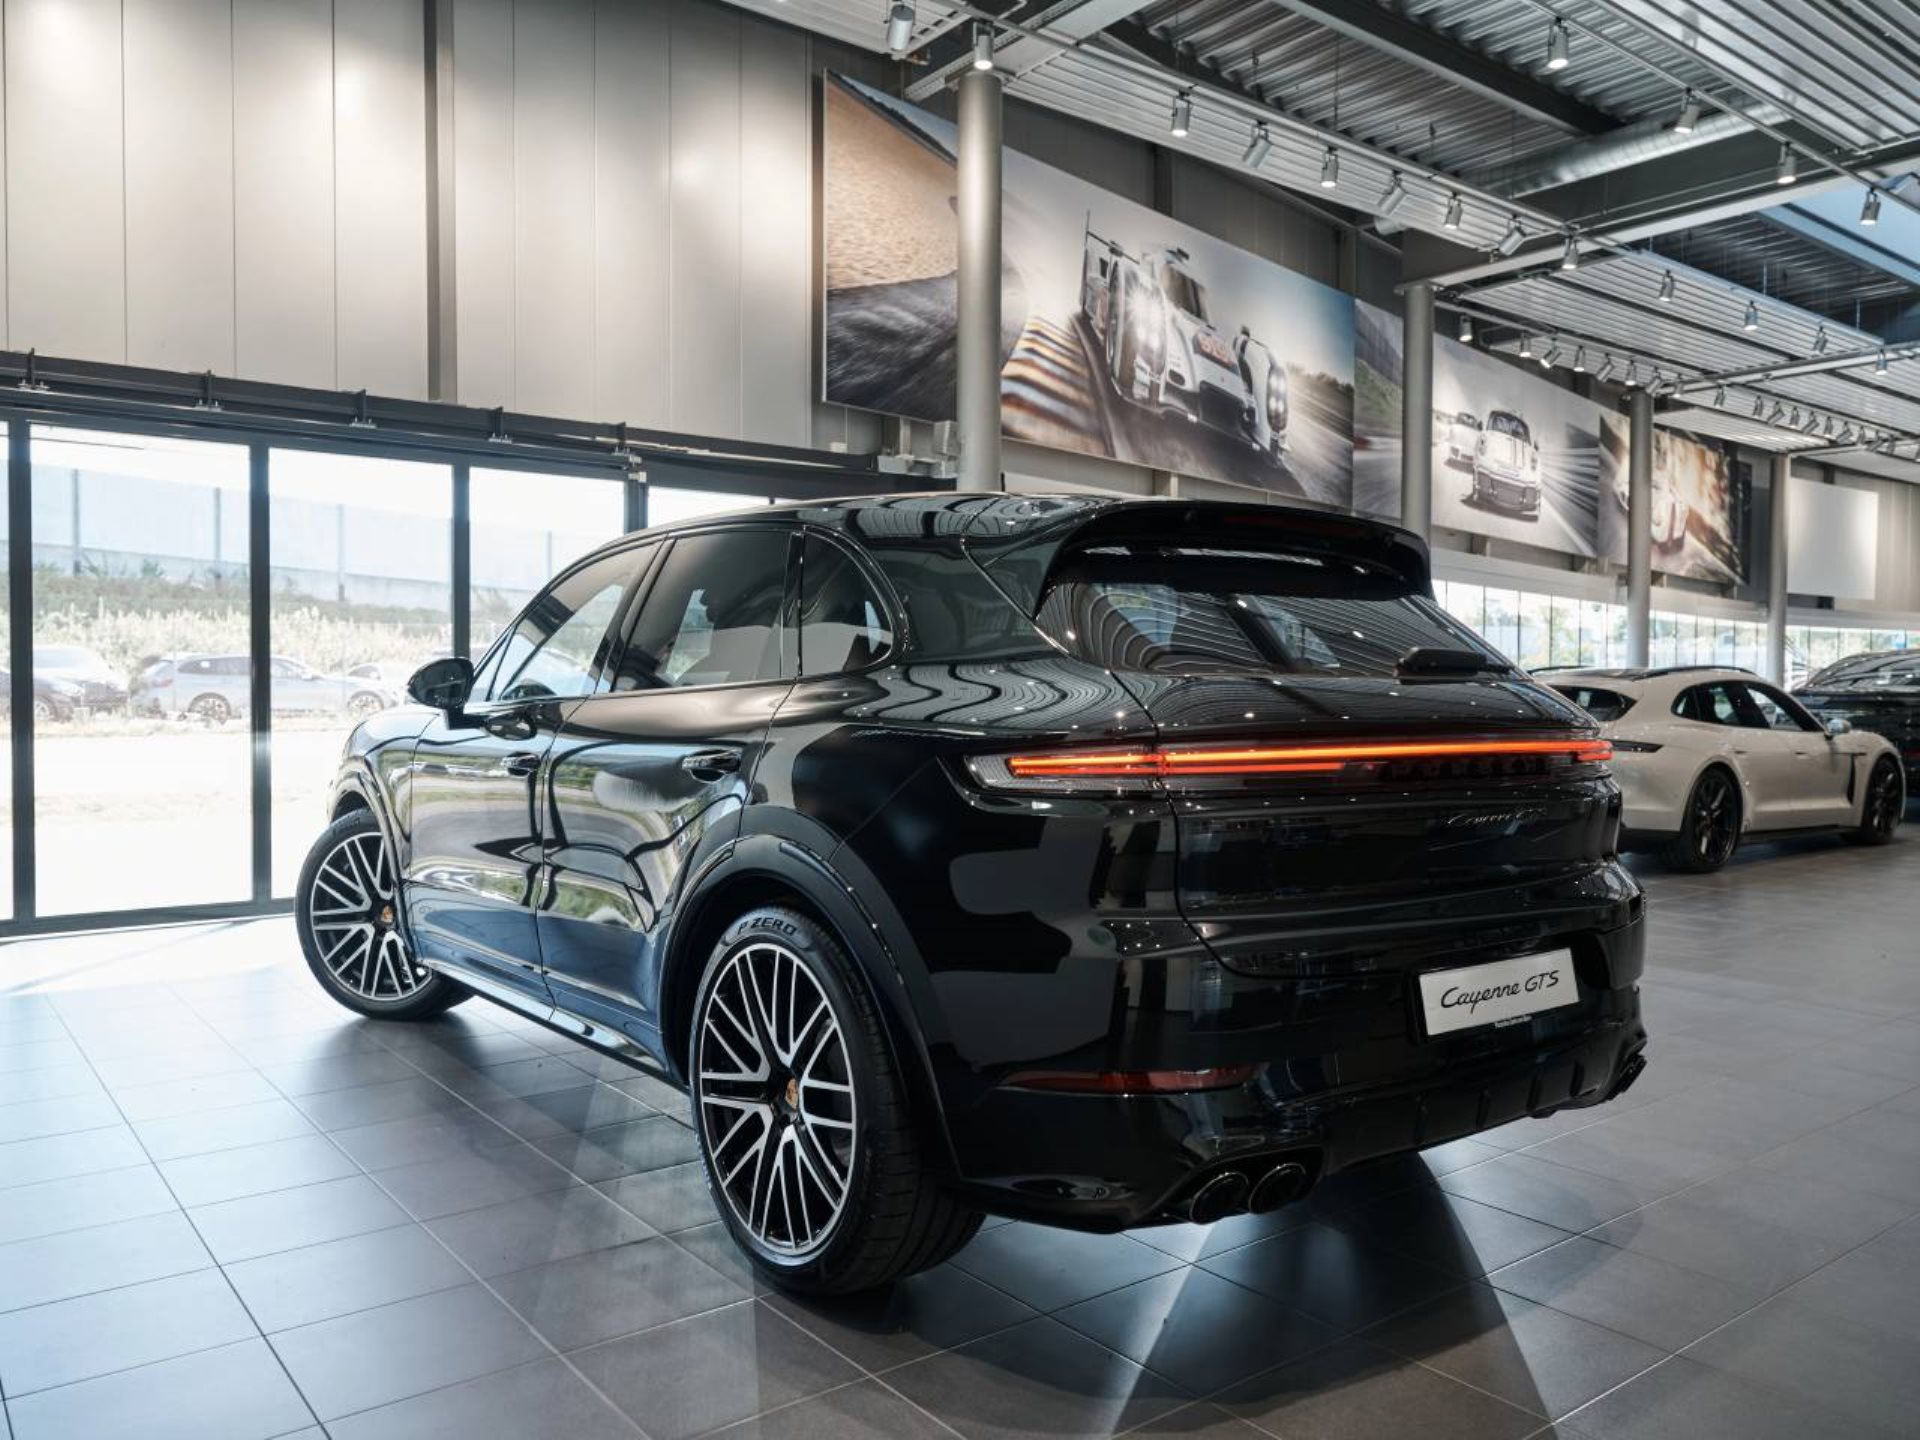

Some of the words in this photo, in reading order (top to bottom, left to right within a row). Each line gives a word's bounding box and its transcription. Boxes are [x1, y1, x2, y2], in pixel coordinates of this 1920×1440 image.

[738, 920, 748, 934] P
[752, 917, 798, 935] ZERO
[1440, 983, 1521, 1014] Cayenne
[1524, 970, 1560, 992] GTS
